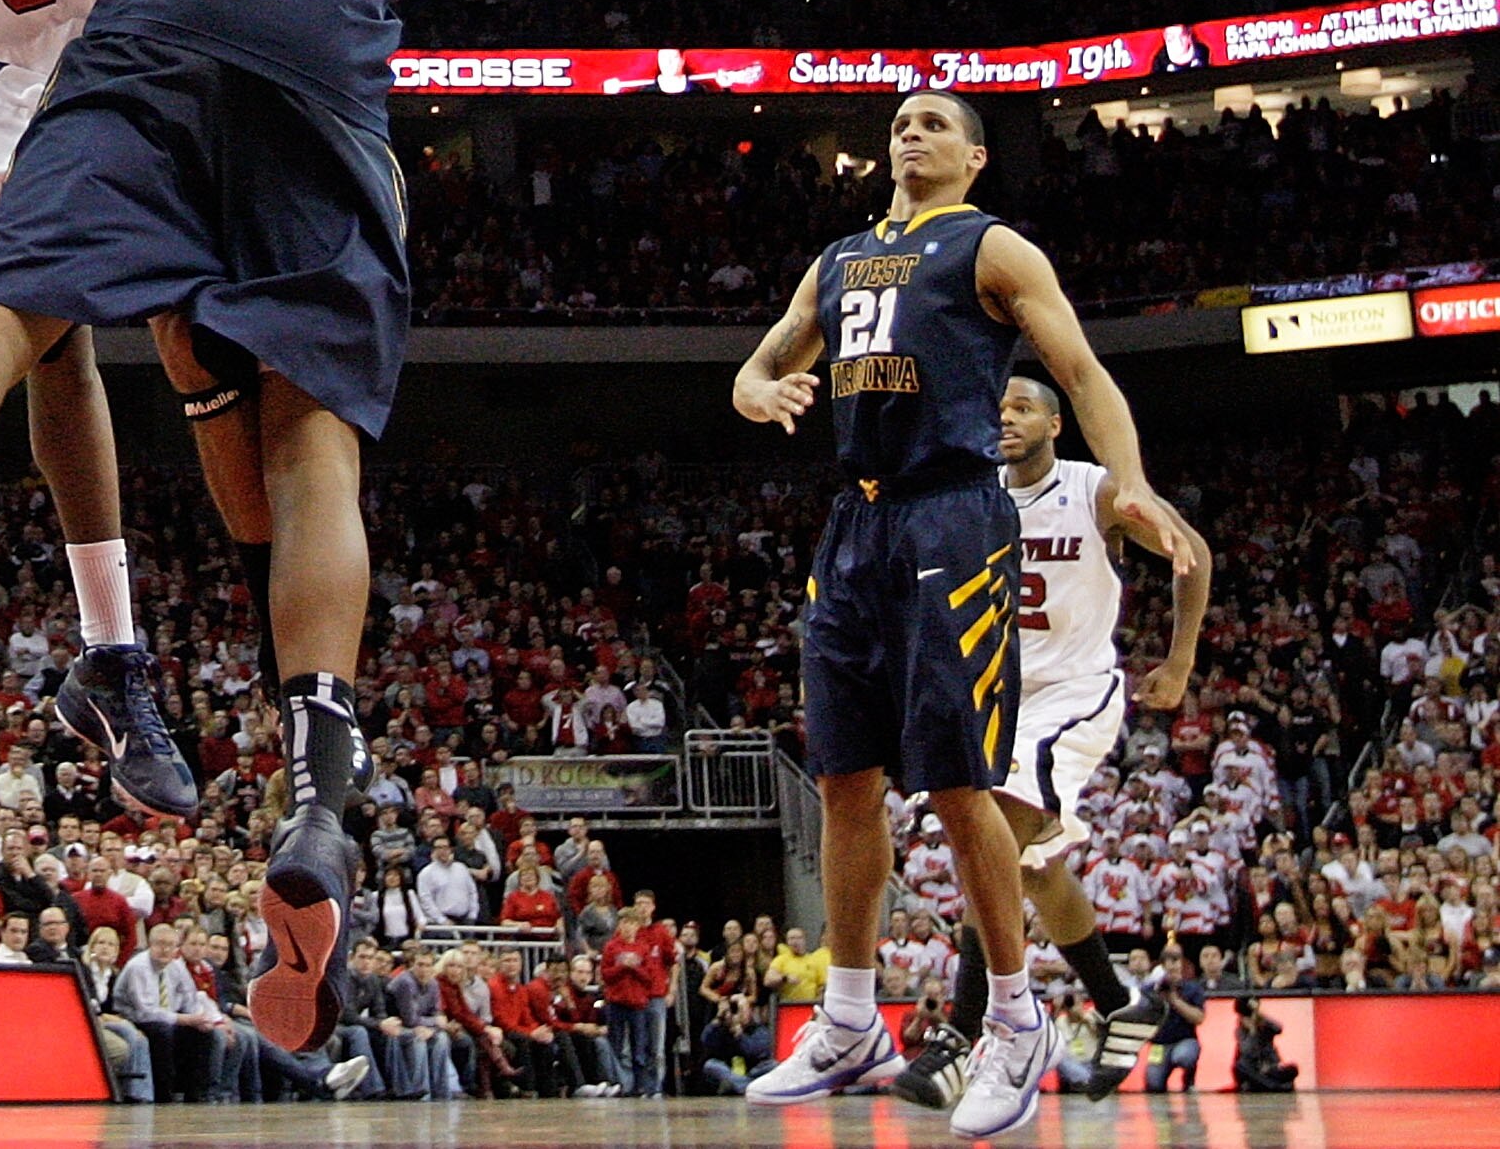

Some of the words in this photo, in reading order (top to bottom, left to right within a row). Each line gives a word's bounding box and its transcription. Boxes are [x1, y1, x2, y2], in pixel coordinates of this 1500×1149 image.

[1225, 20, 1293, 45] 5:30PM
[1321, 13, 1347, 31] AT
[1347, 7, 1377, 28] THE
[1227, 41, 1271, 60] PAPA
[1272, 31, 1329, 56] JOHNS
[1331, 22, 1418, 47] CARDINAL
[1421, 9, 1498, 34] STADIUM
[391, 57, 572, 87] CROSSE
[789, 53, 922, 92] Saturday,
[930, 52, 1056, 89] February
[1067, 39, 1133, 77] 19th
[843, 253, 921, 289] WEST
[839, 286, 898, 358] 21
[1310, 307, 1385, 325] NORTON
[184, 389, 240, 416] Mueller
[1019, 536, 1083, 562] VILLE
[1018, 572, 1051, 630] 2
